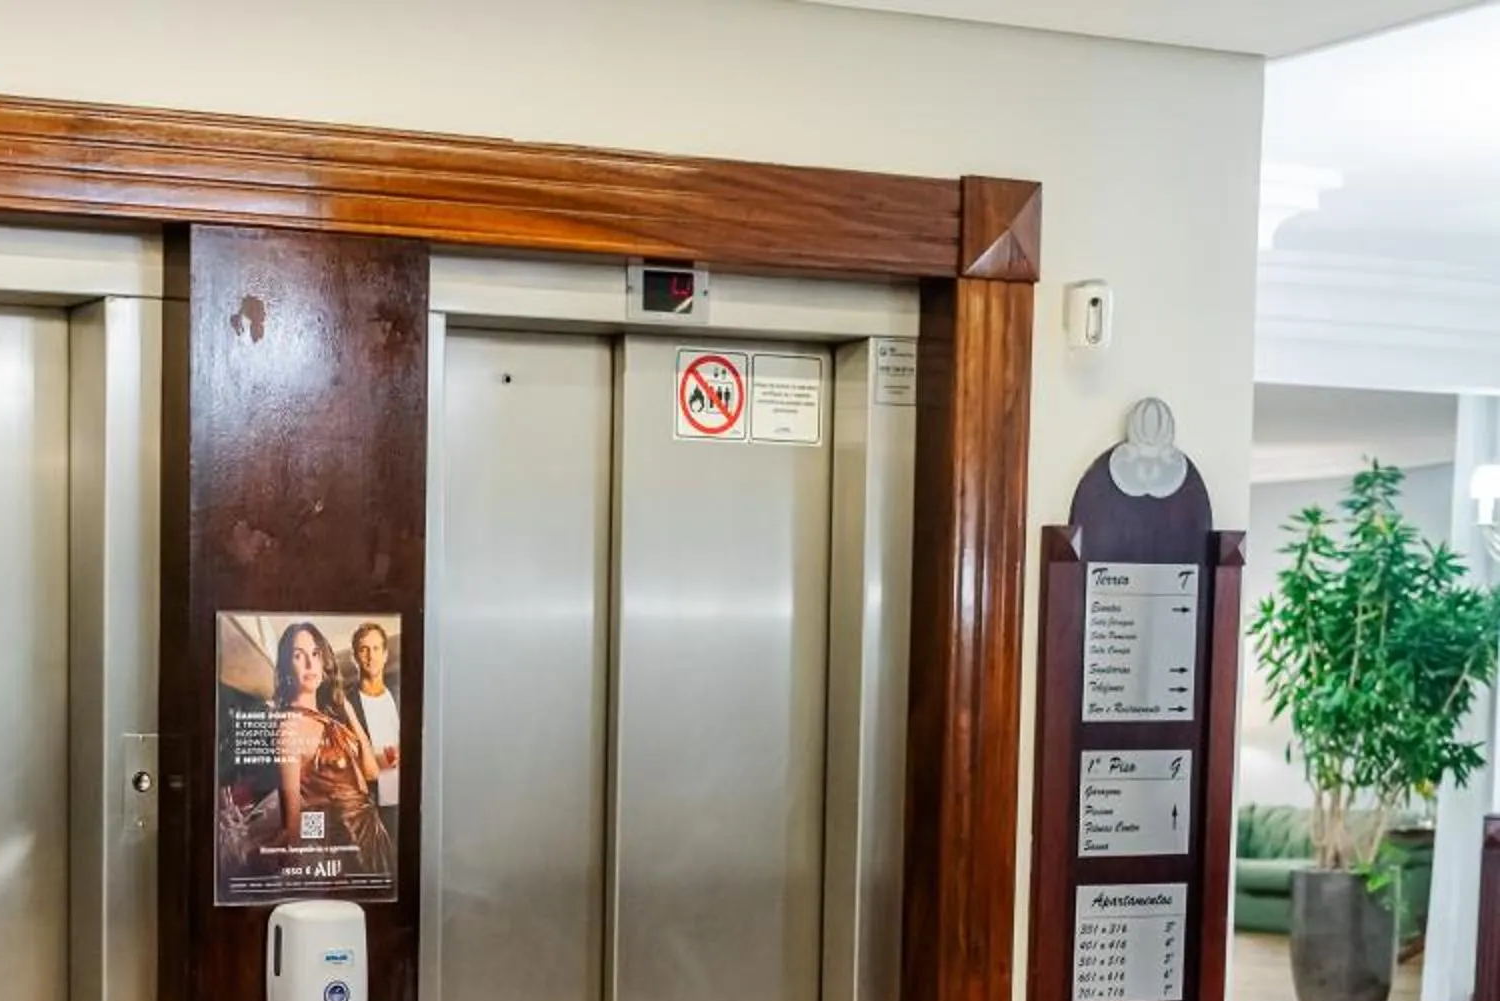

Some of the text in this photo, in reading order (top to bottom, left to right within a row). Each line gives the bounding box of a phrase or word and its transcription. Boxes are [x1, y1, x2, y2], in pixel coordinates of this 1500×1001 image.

[1178, 570, 1196, 590] T
[1109, 756, 1137, 774] Piso
[1092, 892, 1173, 910] Apartamentos
